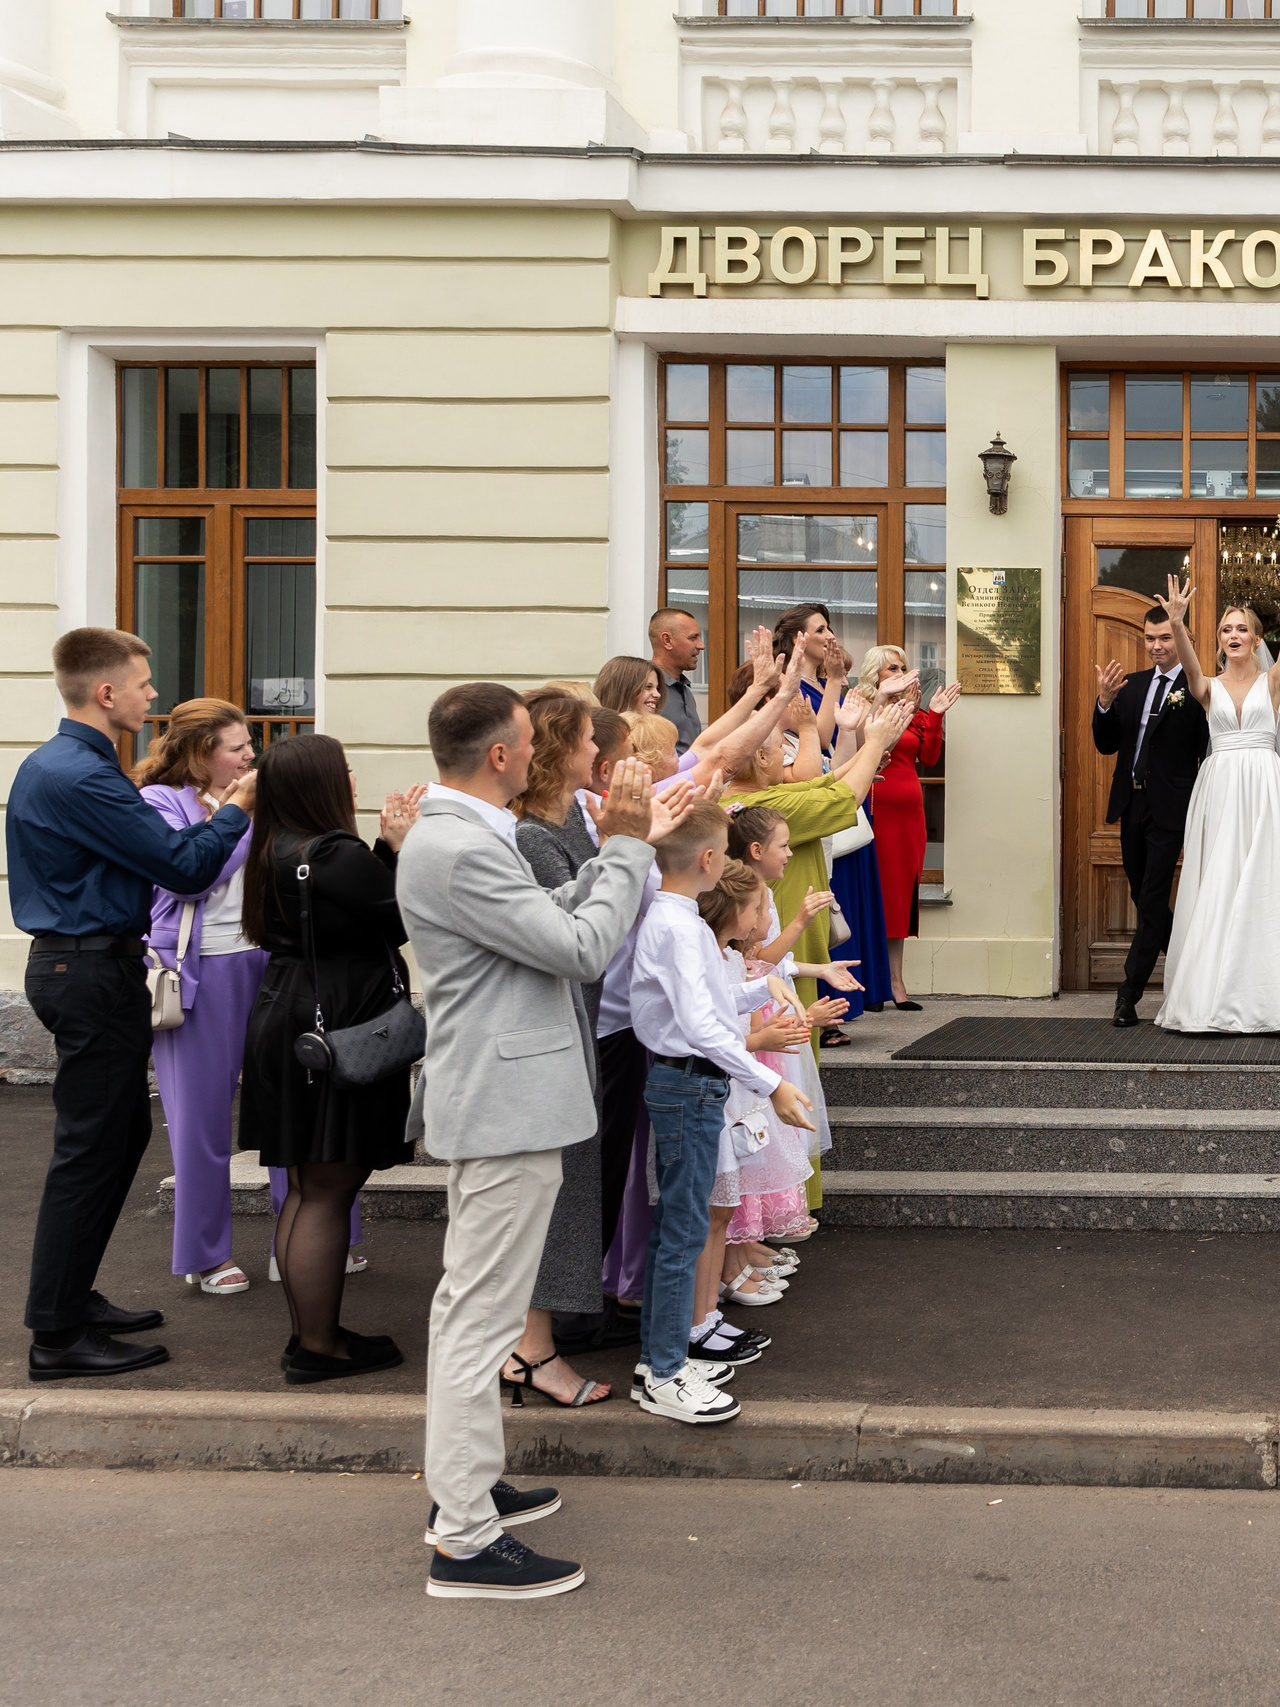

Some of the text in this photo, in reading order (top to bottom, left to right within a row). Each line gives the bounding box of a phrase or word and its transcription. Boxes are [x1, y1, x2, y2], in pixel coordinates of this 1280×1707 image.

[648, 226, 989, 299] ДВОРЕЦ
[968, 585, 1030, 594] Отдел ЗАГС
